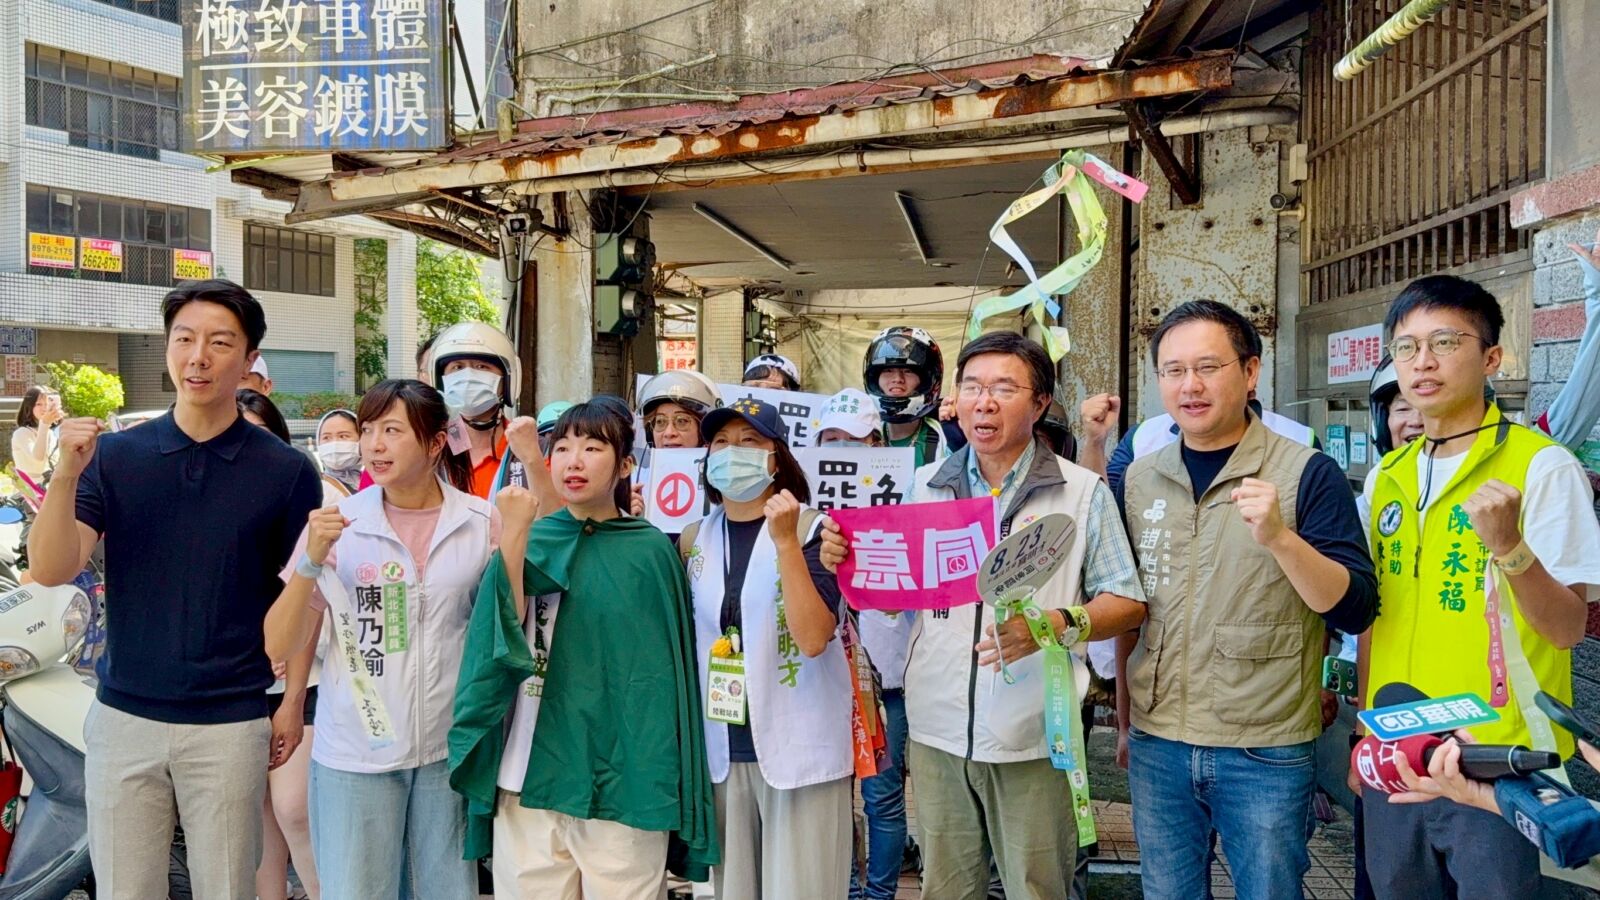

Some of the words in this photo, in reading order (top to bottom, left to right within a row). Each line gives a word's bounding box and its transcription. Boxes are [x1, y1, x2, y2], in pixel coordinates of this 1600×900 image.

[195, 0, 428, 57] 極致車體
[196, 71, 429, 142] 美容鍍膜
[1330, 337, 1350, 358] 出入口
[1349, 337, 1380, 373] 請勿停車
[1389, 540, 1403, 576] 特助
[26, 620, 47, 635] SYM
[386, 587, 400, 650] 新北市議員
[1379, 712, 1420, 731] CTS
[1414, 698, 1489, 725] 華視
